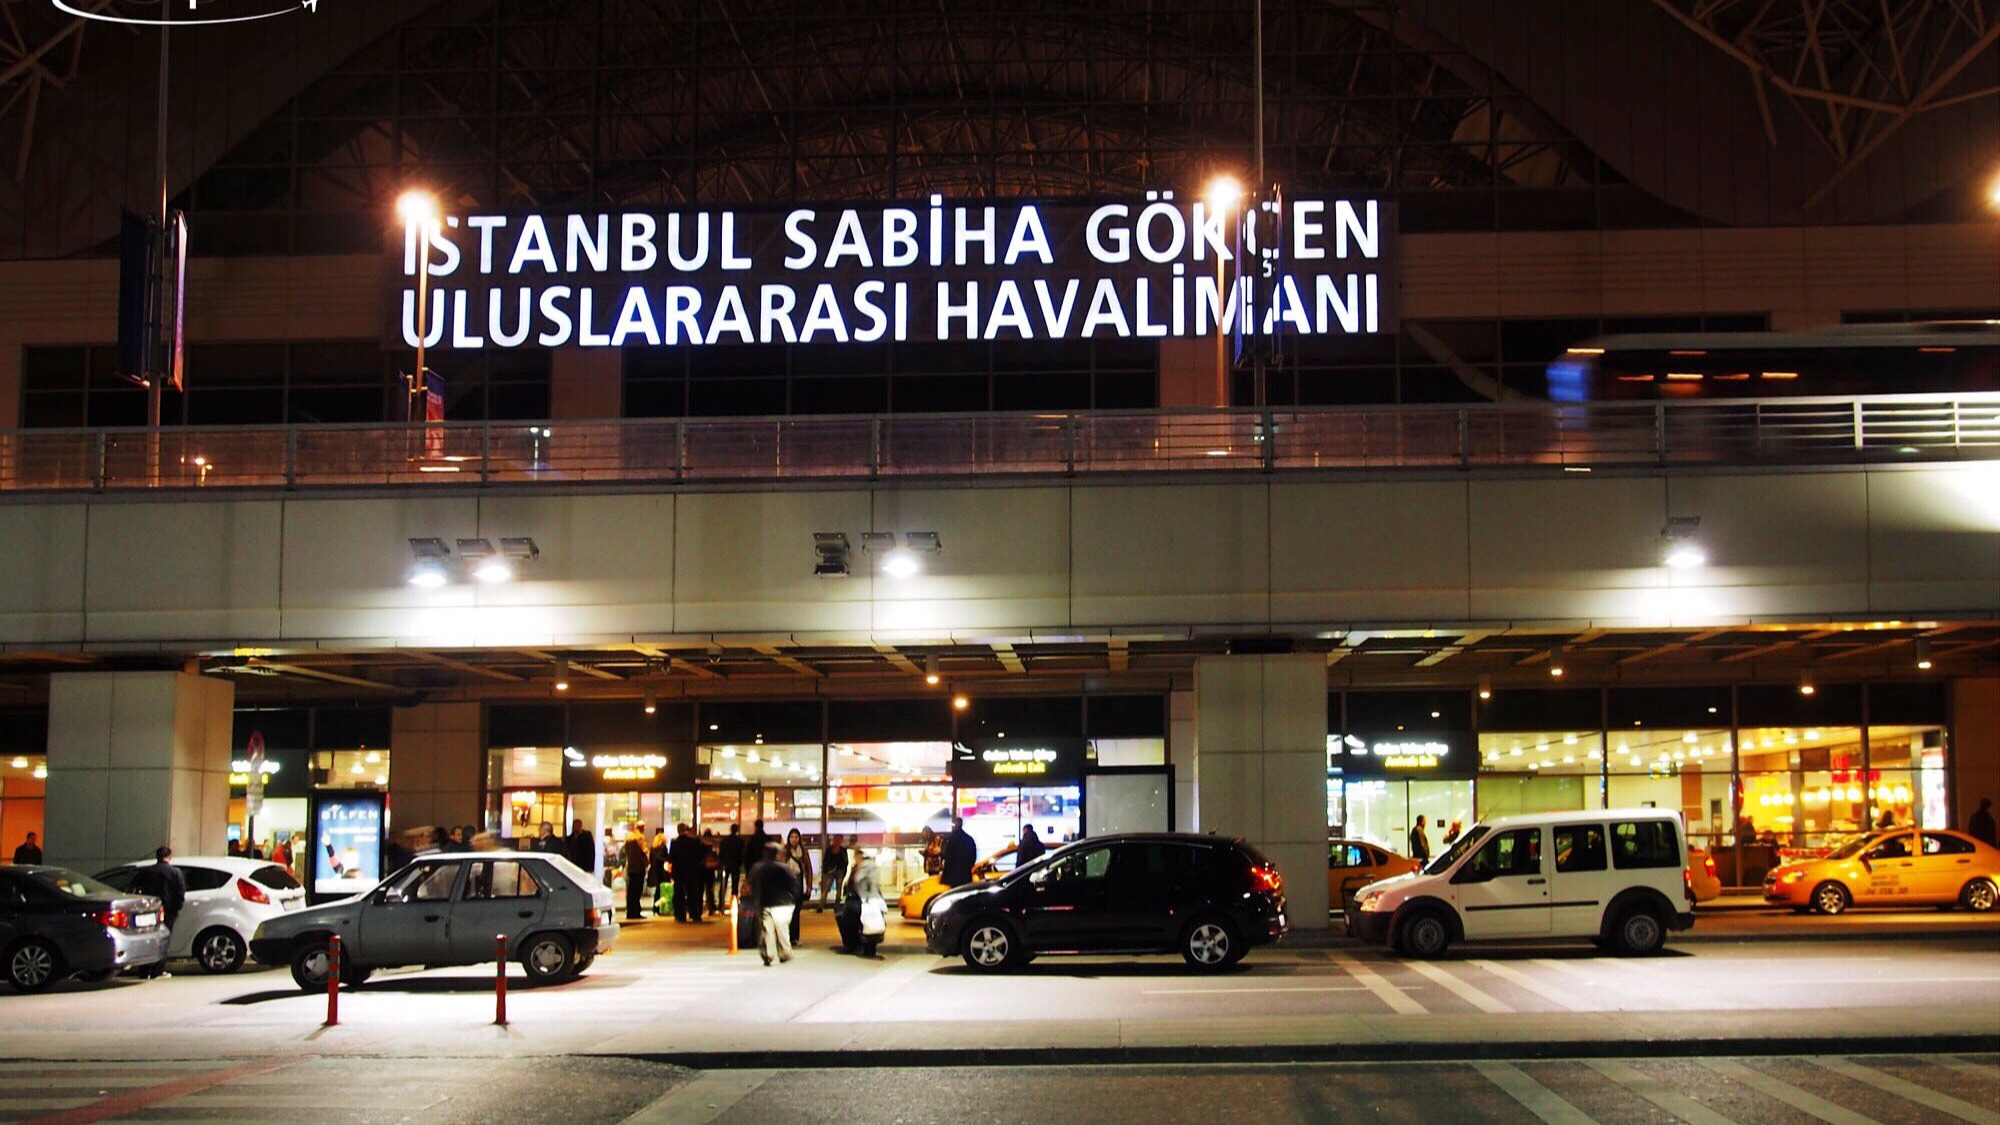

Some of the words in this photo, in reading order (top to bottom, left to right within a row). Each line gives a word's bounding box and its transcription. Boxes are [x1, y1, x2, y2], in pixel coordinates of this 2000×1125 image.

[784, 194, 1054, 270] SABİHA
[402, 280, 907, 349] ULUSLARARASI
[936, 263, 1379, 341] HAVALİMANI
